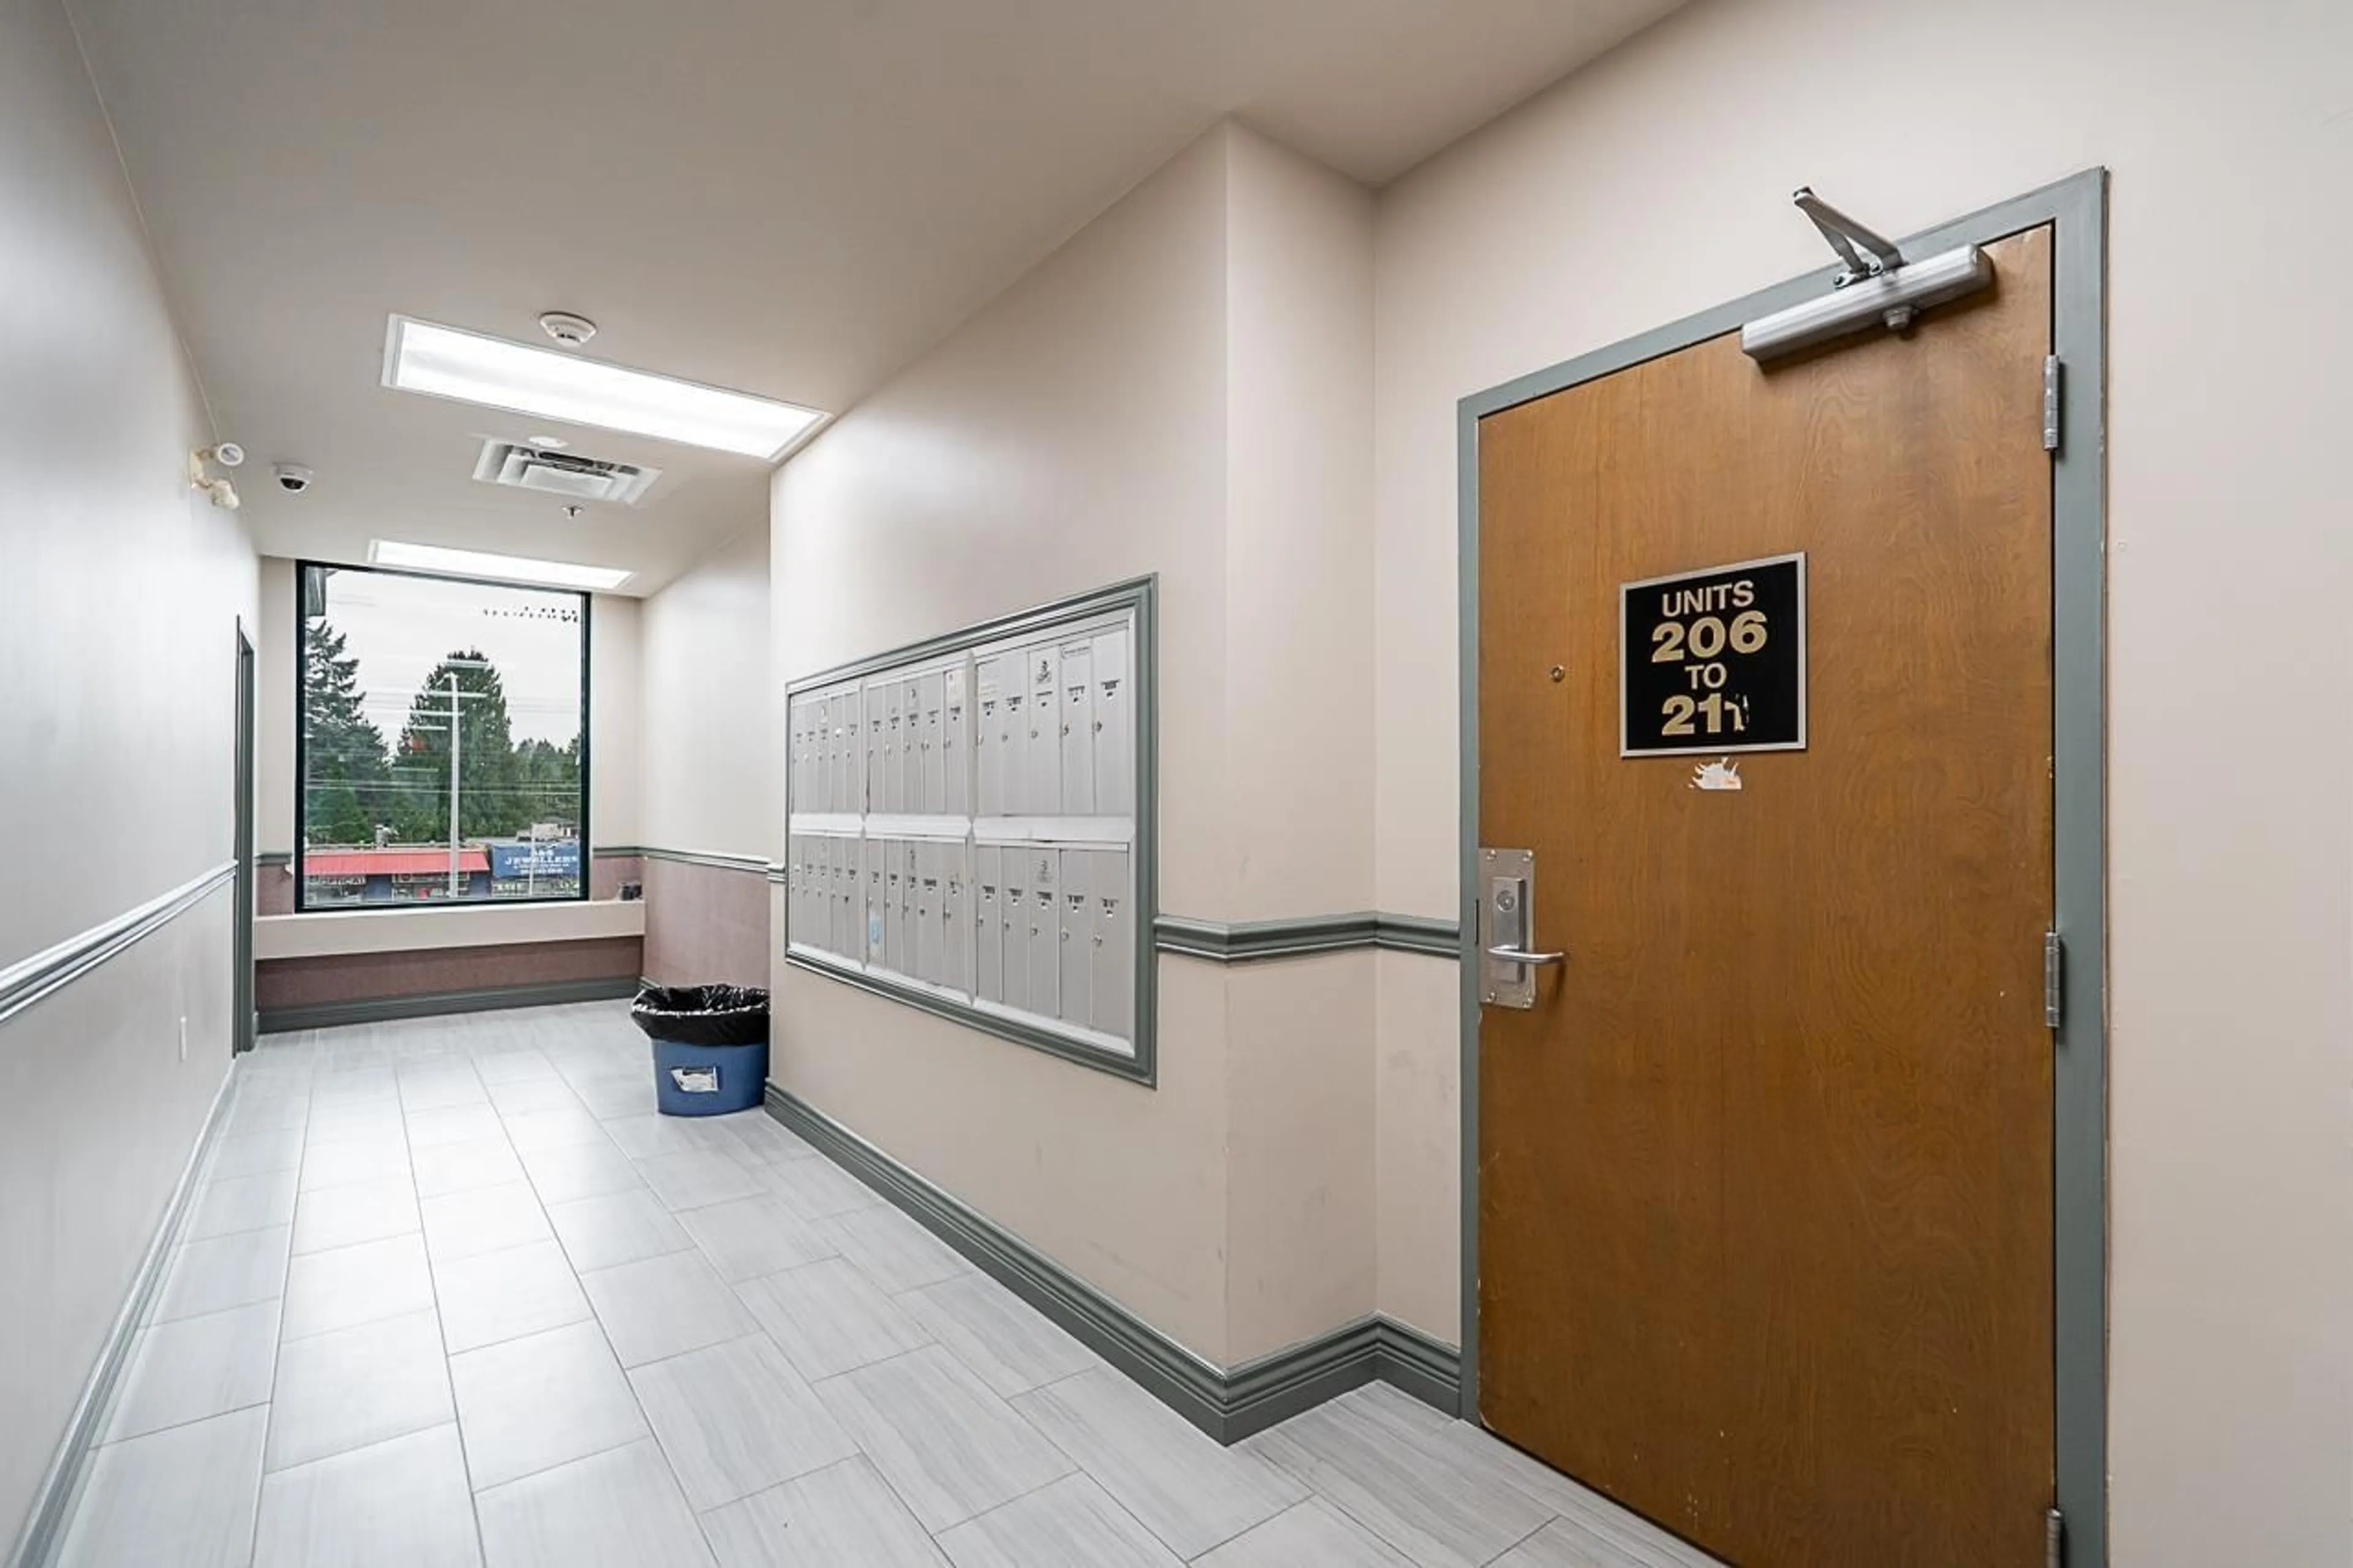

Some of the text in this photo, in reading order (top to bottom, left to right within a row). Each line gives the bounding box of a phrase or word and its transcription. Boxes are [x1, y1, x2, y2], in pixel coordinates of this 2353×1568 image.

[1662, 580, 1755, 618] UNITS
[1651, 610, 1768, 663] 206
[1684, 662, 1727, 691] TO
